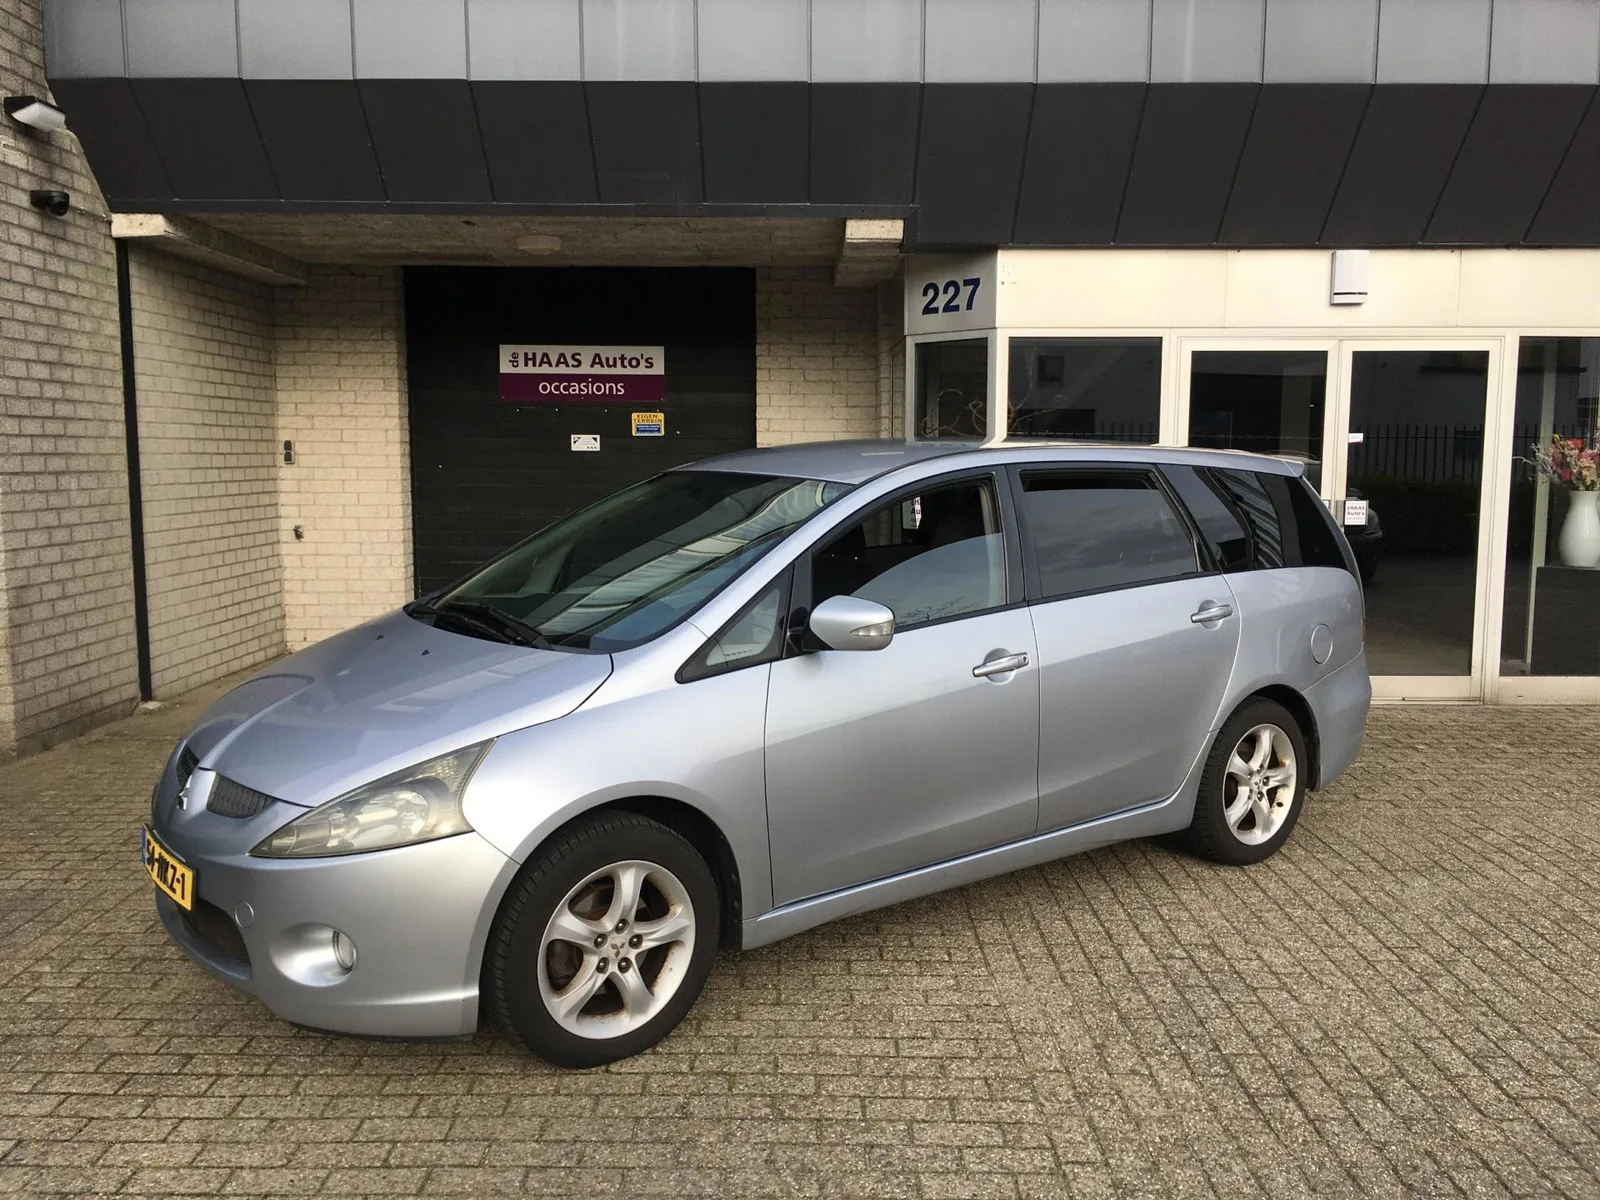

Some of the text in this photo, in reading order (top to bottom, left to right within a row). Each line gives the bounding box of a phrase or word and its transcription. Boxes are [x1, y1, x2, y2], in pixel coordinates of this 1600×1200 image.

[922, 277, 981, 315] 227
[509, 352, 654, 369] de HAAS Auto's
[538, 378, 625, 395] occasions
